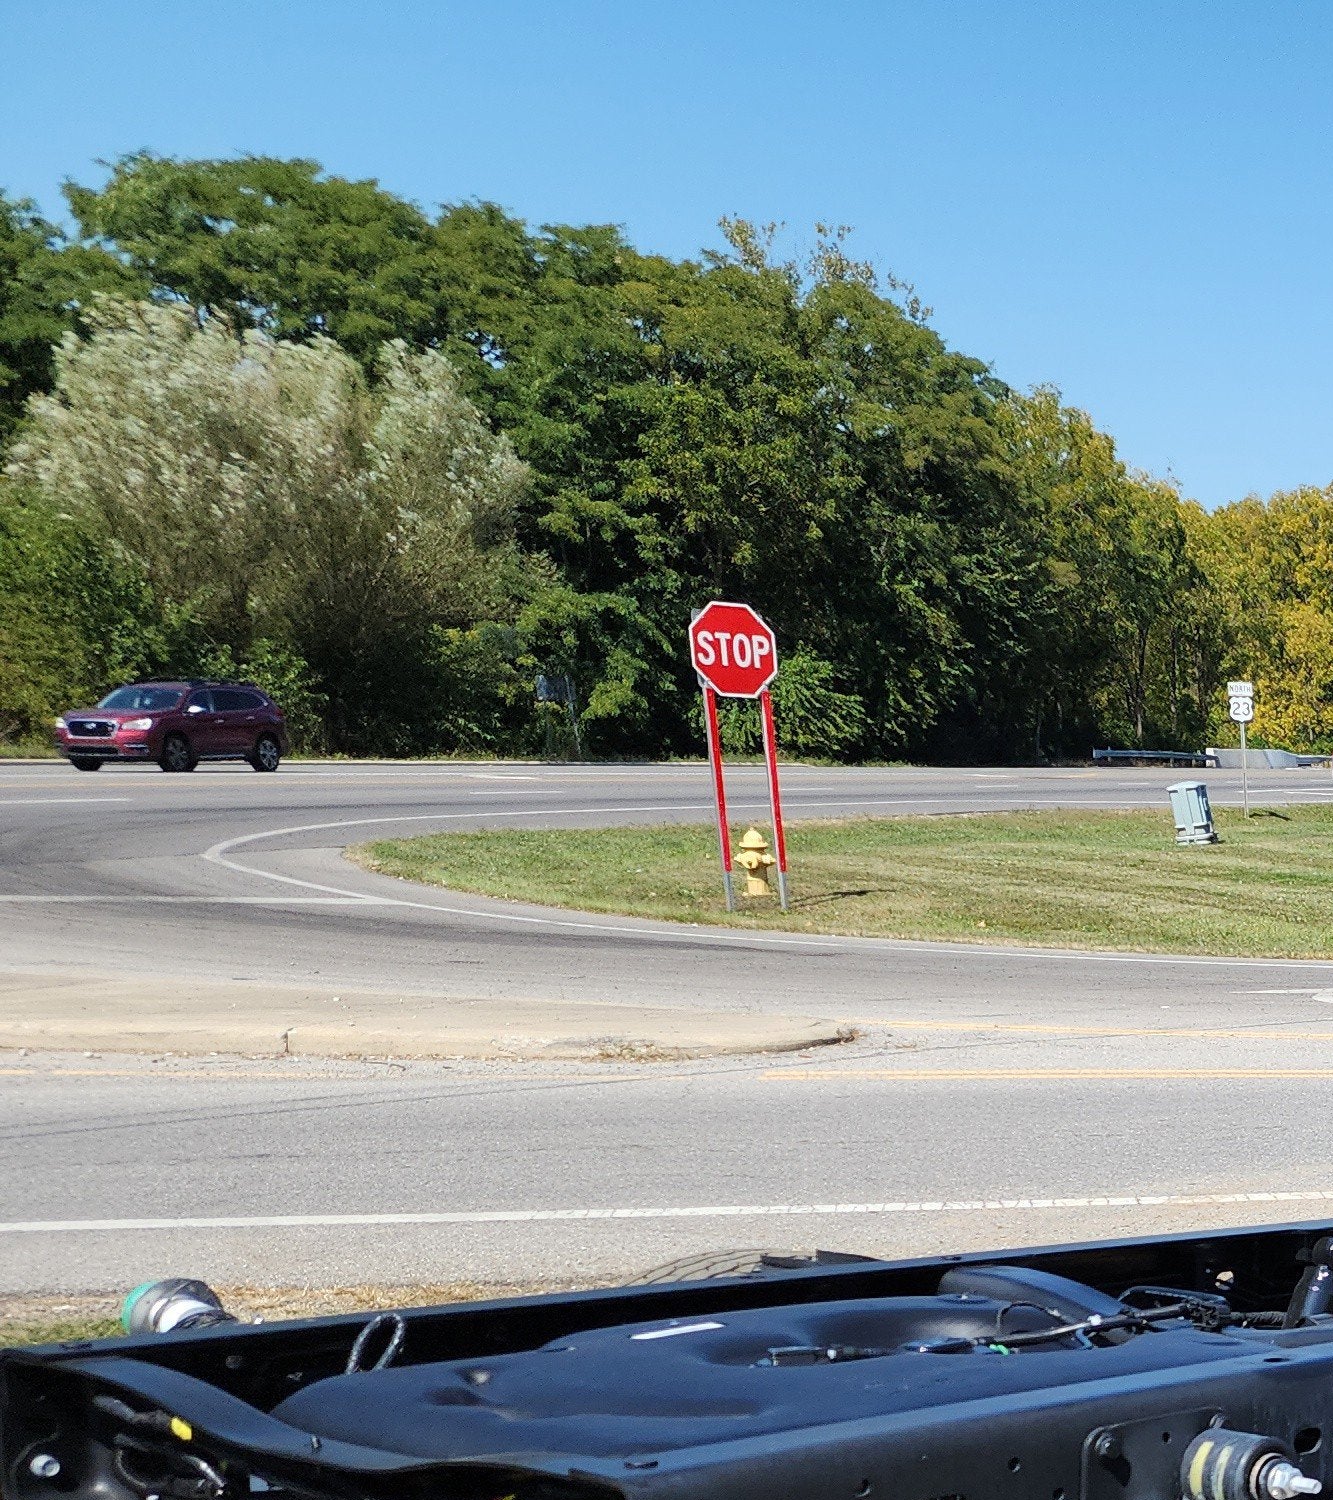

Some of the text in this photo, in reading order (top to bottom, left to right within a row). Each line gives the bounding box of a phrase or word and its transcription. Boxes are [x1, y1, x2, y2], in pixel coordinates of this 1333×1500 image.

[697, 630, 770, 669] STOP
[1230, 684, 1251, 693] NORTH
[1232, 702, 1250, 716] 23
